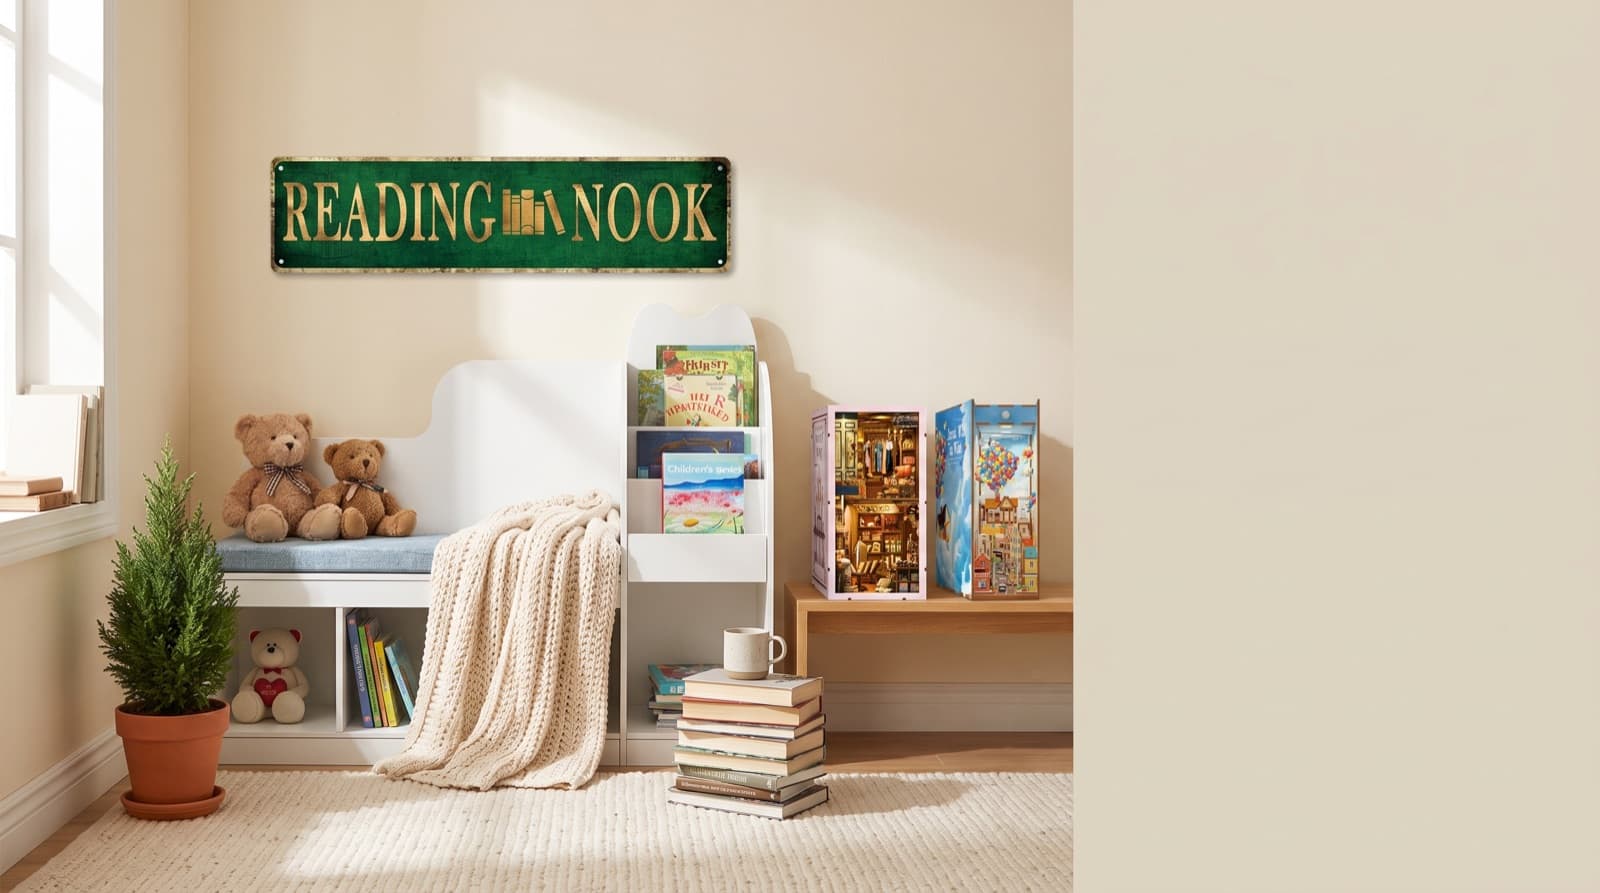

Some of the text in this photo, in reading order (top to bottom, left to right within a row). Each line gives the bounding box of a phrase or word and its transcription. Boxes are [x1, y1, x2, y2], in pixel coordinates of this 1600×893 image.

[282, 181, 718, 243] READING NOOK
[667, 464, 713, 474] Children's
